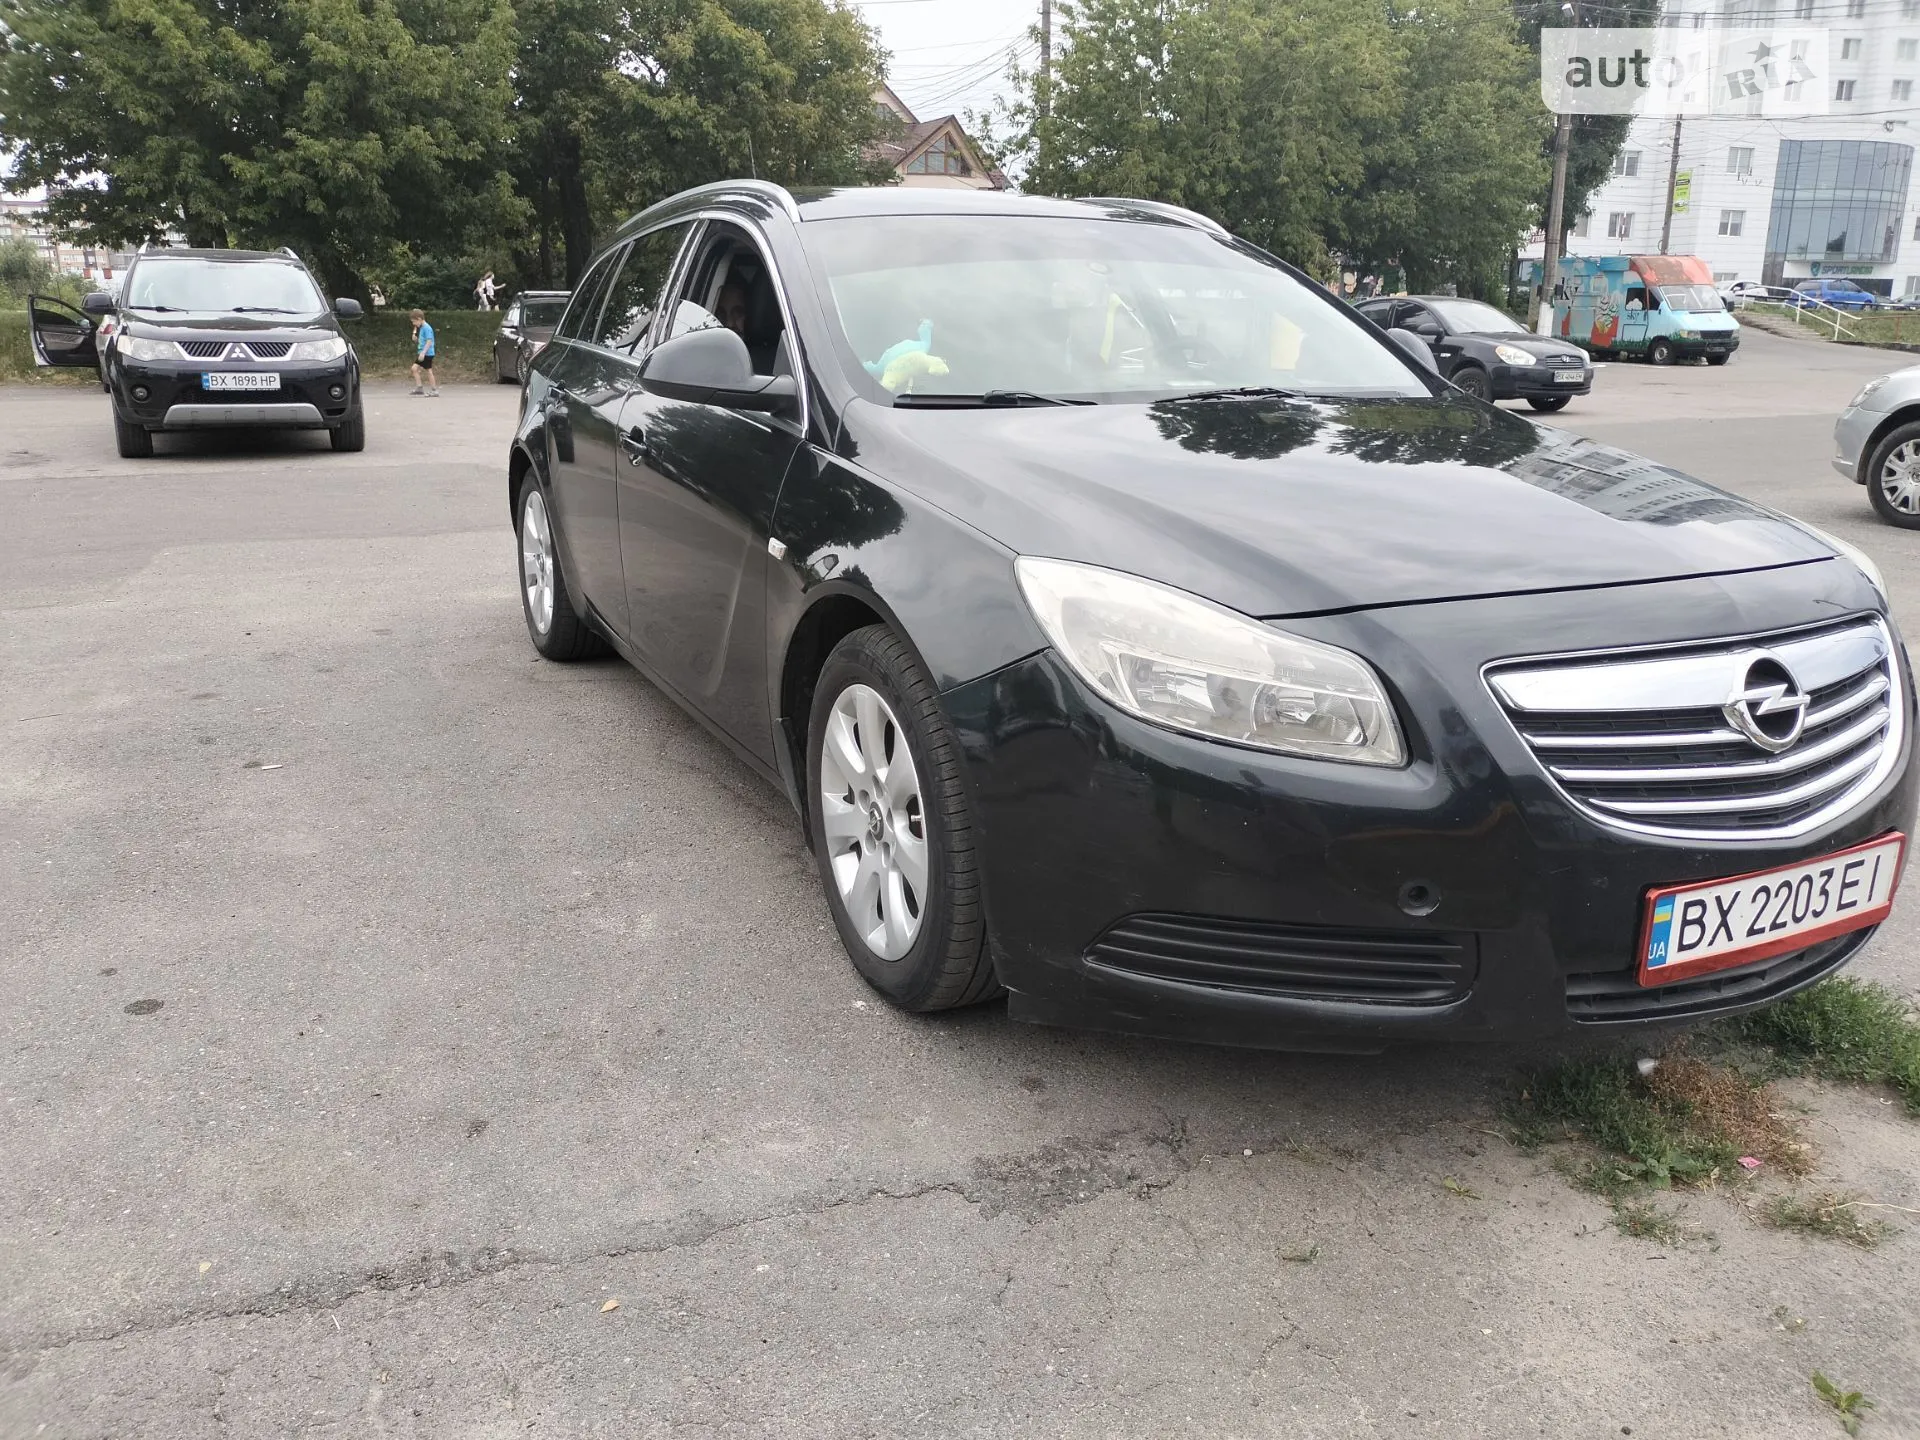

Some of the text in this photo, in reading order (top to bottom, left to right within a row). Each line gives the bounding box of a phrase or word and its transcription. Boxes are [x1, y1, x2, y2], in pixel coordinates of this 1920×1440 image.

[210, 375, 277, 386] BX 1898 HP
[1677, 855, 1881, 953] BX 2203 EI
[1648, 941, 1666, 960] UA
